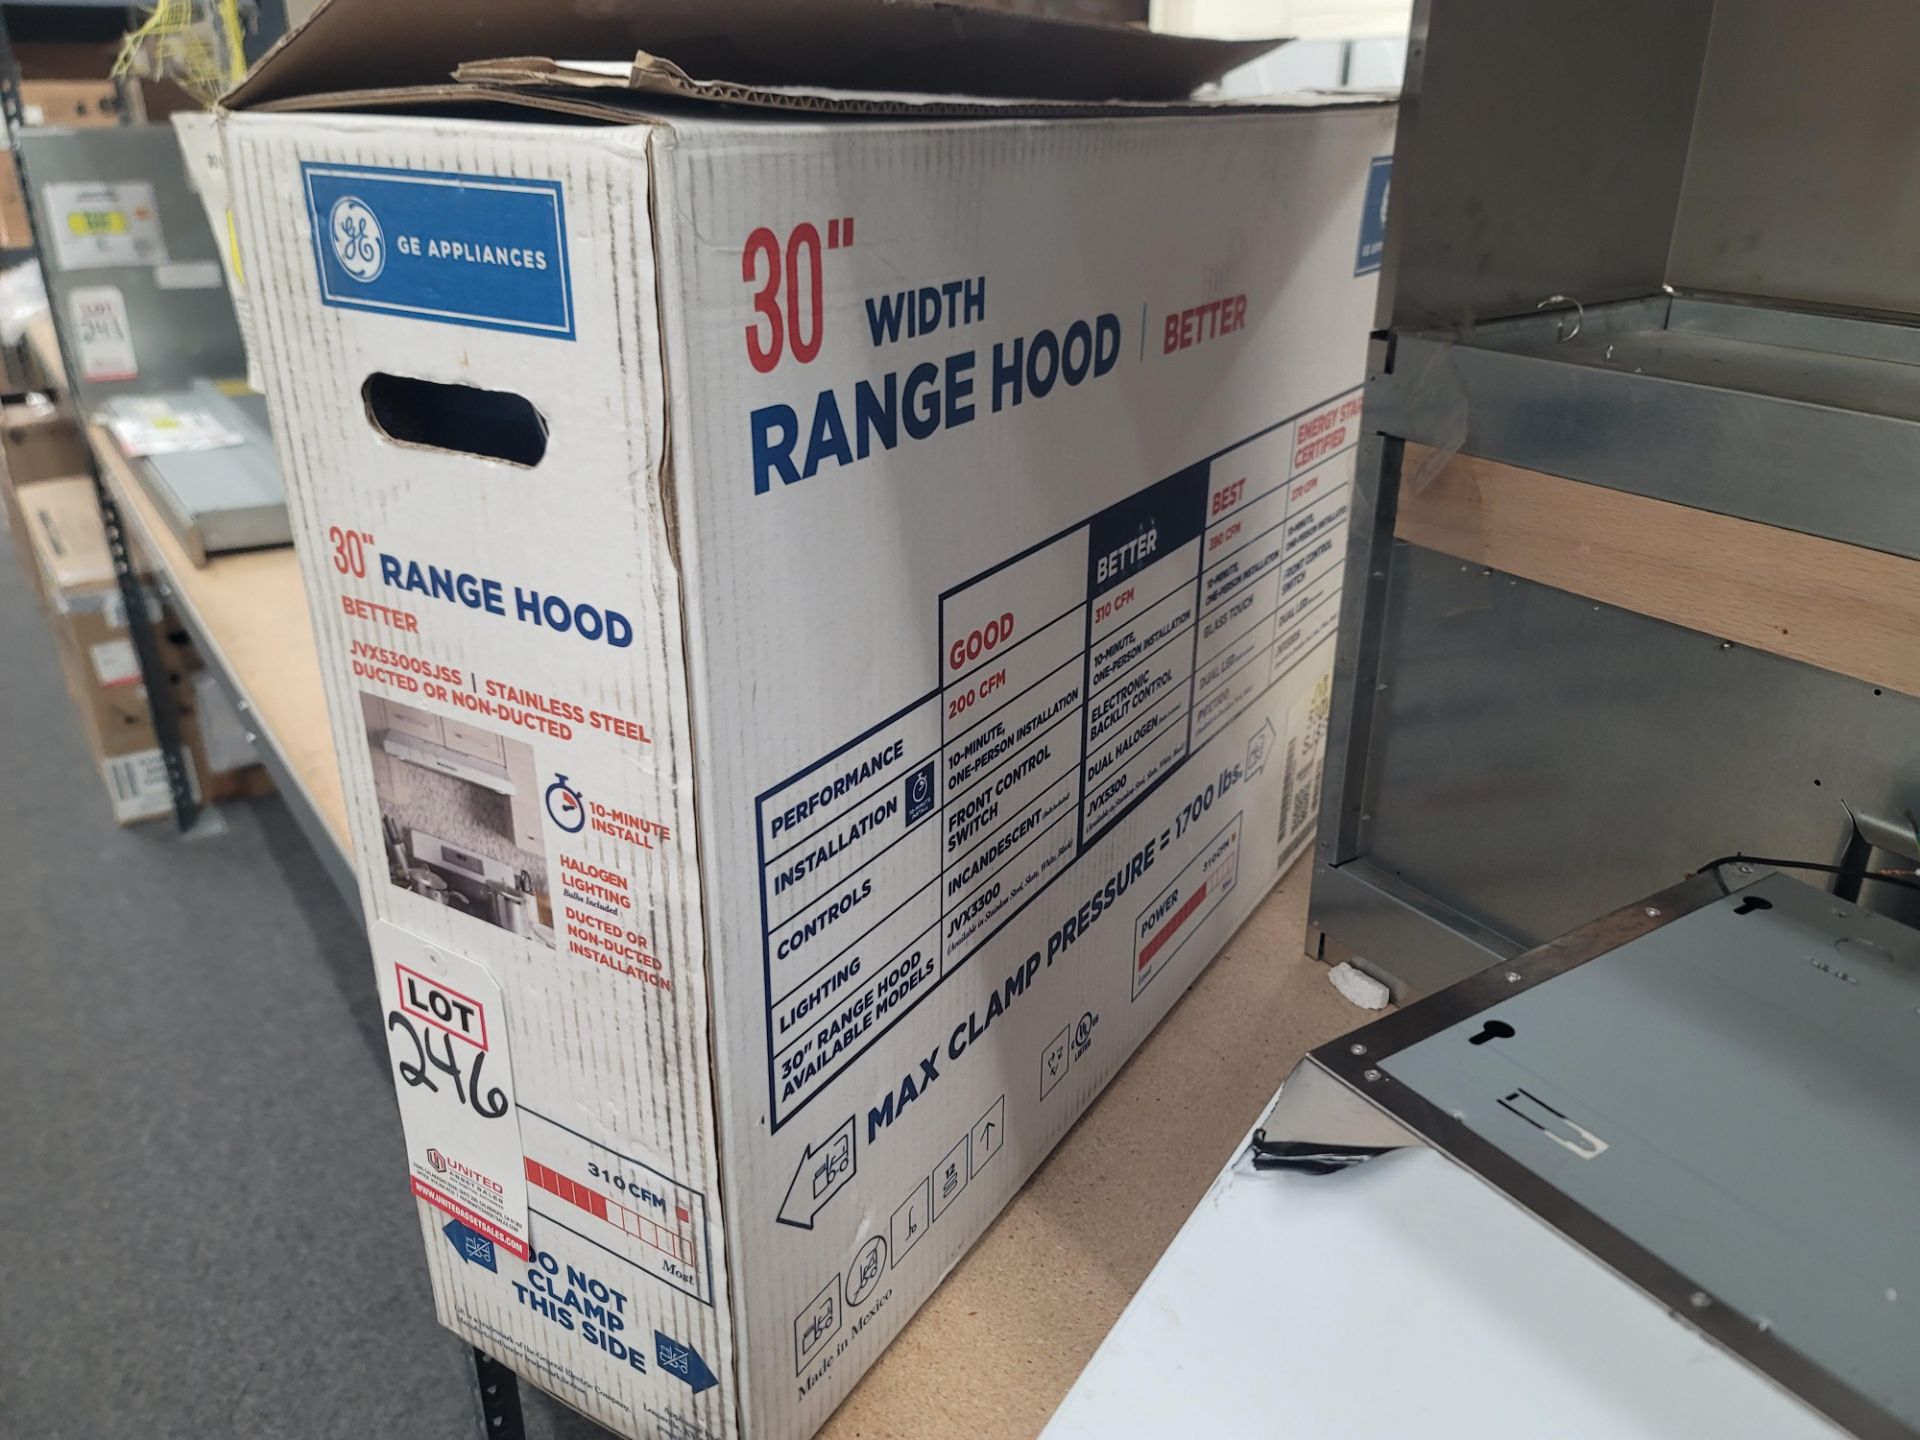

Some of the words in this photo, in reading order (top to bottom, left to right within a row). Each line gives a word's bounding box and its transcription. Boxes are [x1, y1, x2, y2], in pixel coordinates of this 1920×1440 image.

[397, 235, 421, 256] GE
[428, 238, 548, 271] APPLIANCES
[742, 217, 853, 373] 30"
[865, 276, 985, 348] WIDTH
[1163, 294, 1247, 356] BETTER
[750, 350, 976, 496] RANGE
[991, 313, 1121, 413] HOOD
[1297, 408, 1338, 446] ENERGY
[1295, 426, 1346, 469] CERTIFIED
[1212, 476, 1247, 517] BEST
[1097, 528, 1157, 584] BETTER
[329, 525, 375, 579] 30"
[379, 553, 506, 616] RANGE
[514, 586, 633, 648] HOOD
[341, 595, 418, 634] BETTER
[1095, 602, 1112, 624] 310
[1114, 587, 1135, 611] CFM
[950, 612, 1014, 670] GOOD
[1093, 645, 1141, 686] ONE-PERSON
[1143, 608, 1191, 650] INSTALLATION
[351, 640, 462, 686] JVX5300SJSS
[486, 679, 585, 724] STAINLESS
[589, 710, 652, 744] STEEL
[352, 659, 419, 693] DUCTED
[423, 682, 448, 702] OR
[452, 691, 572, 741] NON-DUCTED
[949, 689, 976, 720] 200
[979, 668, 1006, 699] CFM
[1090, 701, 1130, 741] BACKLIT
[1132, 668, 1173, 708] CONTROL
[1091, 669, 1150, 723] ELECTRONIC
[948, 733, 1014, 790] ONE-PERSON
[1016, 688, 1078, 742] INSTALLATION
[949, 722, 1006, 769] 10-MINUTE,
[1087, 752, 1113, 782] DUAL
[1115, 714, 1158, 759] HALOGEN
[771, 738, 904, 839] PERFORMANCE
[949, 786, 993, 833] FRONT
[995, 745, 1051, 796] CONTROL
[1086, 774, 1127, 818] JVX5300
[589, 801, 671, 841] 10-MINUTE
[591, 816, 653, 850] INSTALL
[774, 796, 897, 896] INSTALLATION
[948, 801, 998, 853] SWITCH
[560, 854, 628, 890] HALOGEN
[948, 808, 1042, 897] INCANDESCENT
[561, 872, 631, 909] LIGHTING
[563, 888, 584, 903] Bulbs
[585, 896, 618, 916] Included
[947, 882, 1001, 938] JVX3300
[1141, 888, 1178, 938] POWER
[565, 906, 622, 938] DUCTED
[627, 931, 647, 949] OR
[567, 923, 662, 971] NON-DUCTED
[777, 878, 872, 960] CONTROLS
[569, 940, 671, 992] INSTALLATION
[868, 1043, 940, 1145] MAX
[948, 952, 1041, 1060] CLAMP
[1047, 838, 1156, 967] PRESSURE
[1160, 829, 1171, 851] =
[1174, 784, 1214, 839] 1700
[1217, 762, 1243, 799] lbs.
[408, 977, 474, 1033] LOT
[780, 957, 861, 1034] LIGHTING
[781, 1040, 812, 1080] 30"
[817, 989, 874, 1050] RANGE
[878, 951, 921, 998] HOOD
[781, 1013, 873, 1103] AVAILABLE
[875, 958, 935, 1020] MODELS
[389, 1010, 508, 1118] 246
[446, 1157, 503, 1194] UNITED
[567, 1264, 627, 1314] NOT
[663, 1258, 694, 1286] Most
[512, 1280, 574, 1330] THIS
[582, 1321, 647, 1375] SIDE
[528, 1269, 624, 1332] CLAMP
[798, 1356, 835, 1402] Made
[836, 1339, 849, 1358] in
[851, 1287, 893, 1341] Mexico
